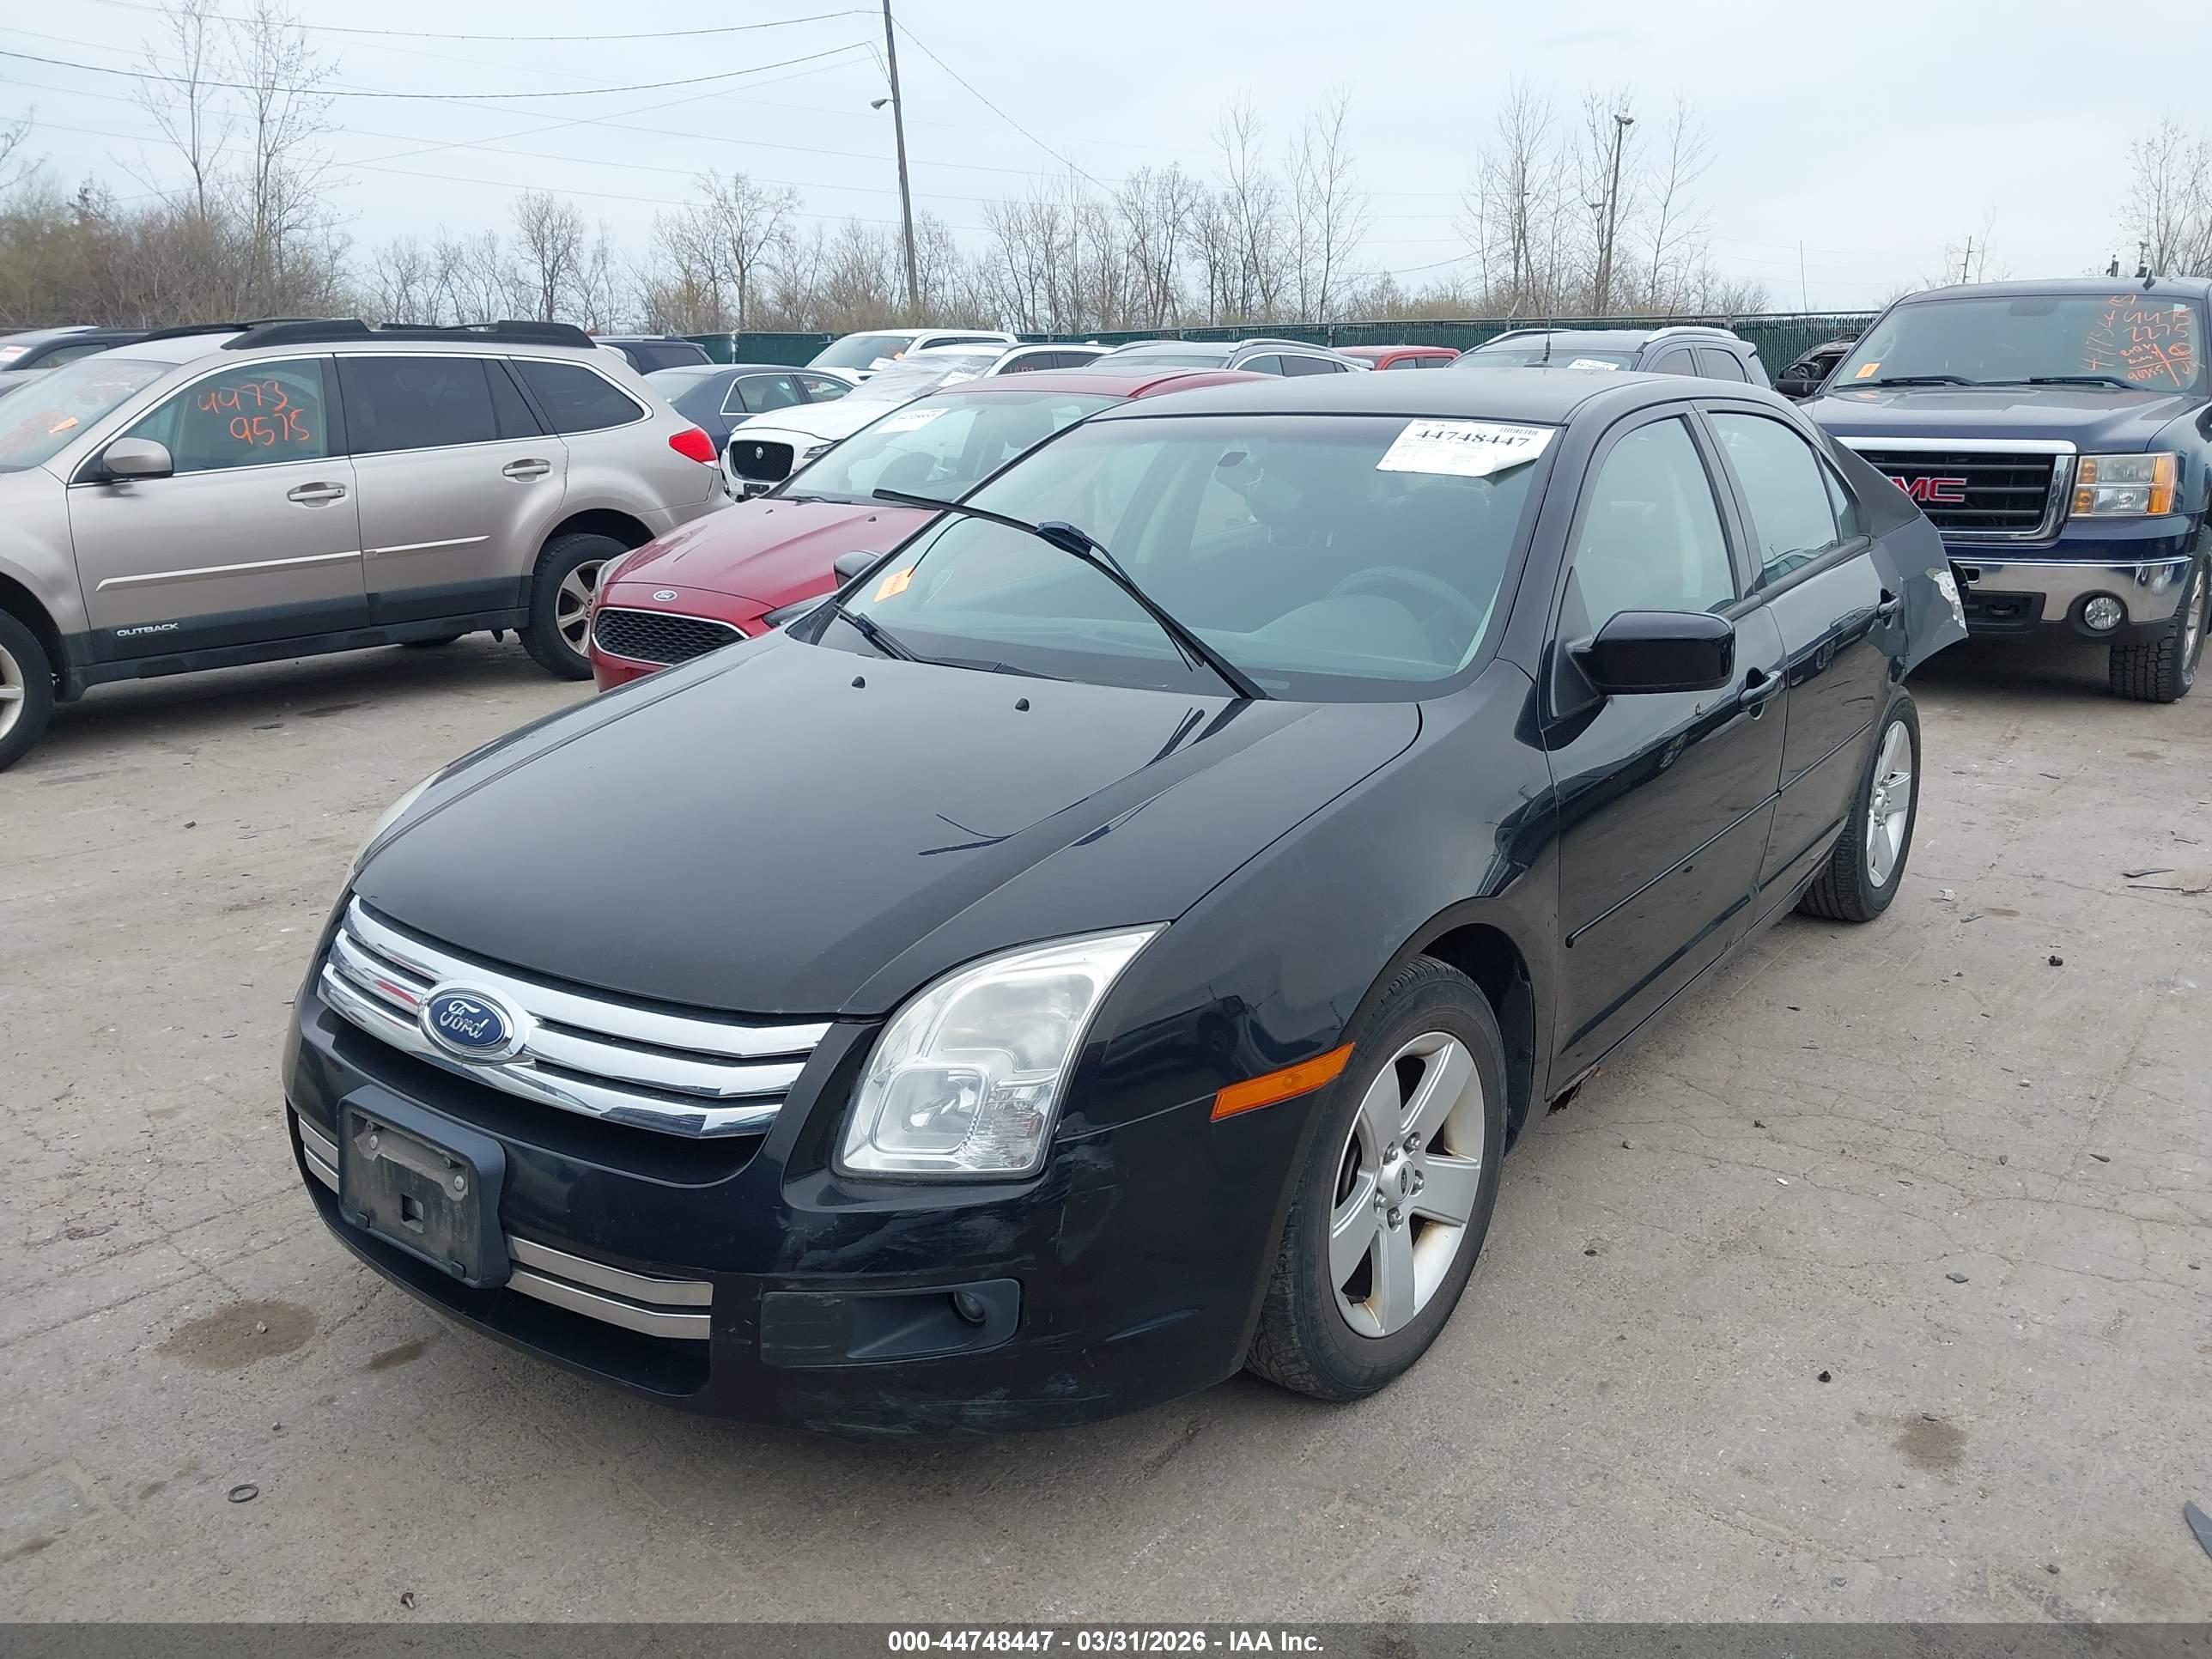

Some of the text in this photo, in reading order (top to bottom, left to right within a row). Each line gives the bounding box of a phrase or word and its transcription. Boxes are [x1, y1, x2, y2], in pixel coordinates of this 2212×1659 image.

[198, 380, 288, 414] 4473
[229, 408, 310, 446] 9575
[1415, 430, 1531, 447] 44748447
[1888, 477, 1967, 502] MC
[117, 623, 179, 636] OUTBACK
[440, 1000, 489, 1039] Ford
